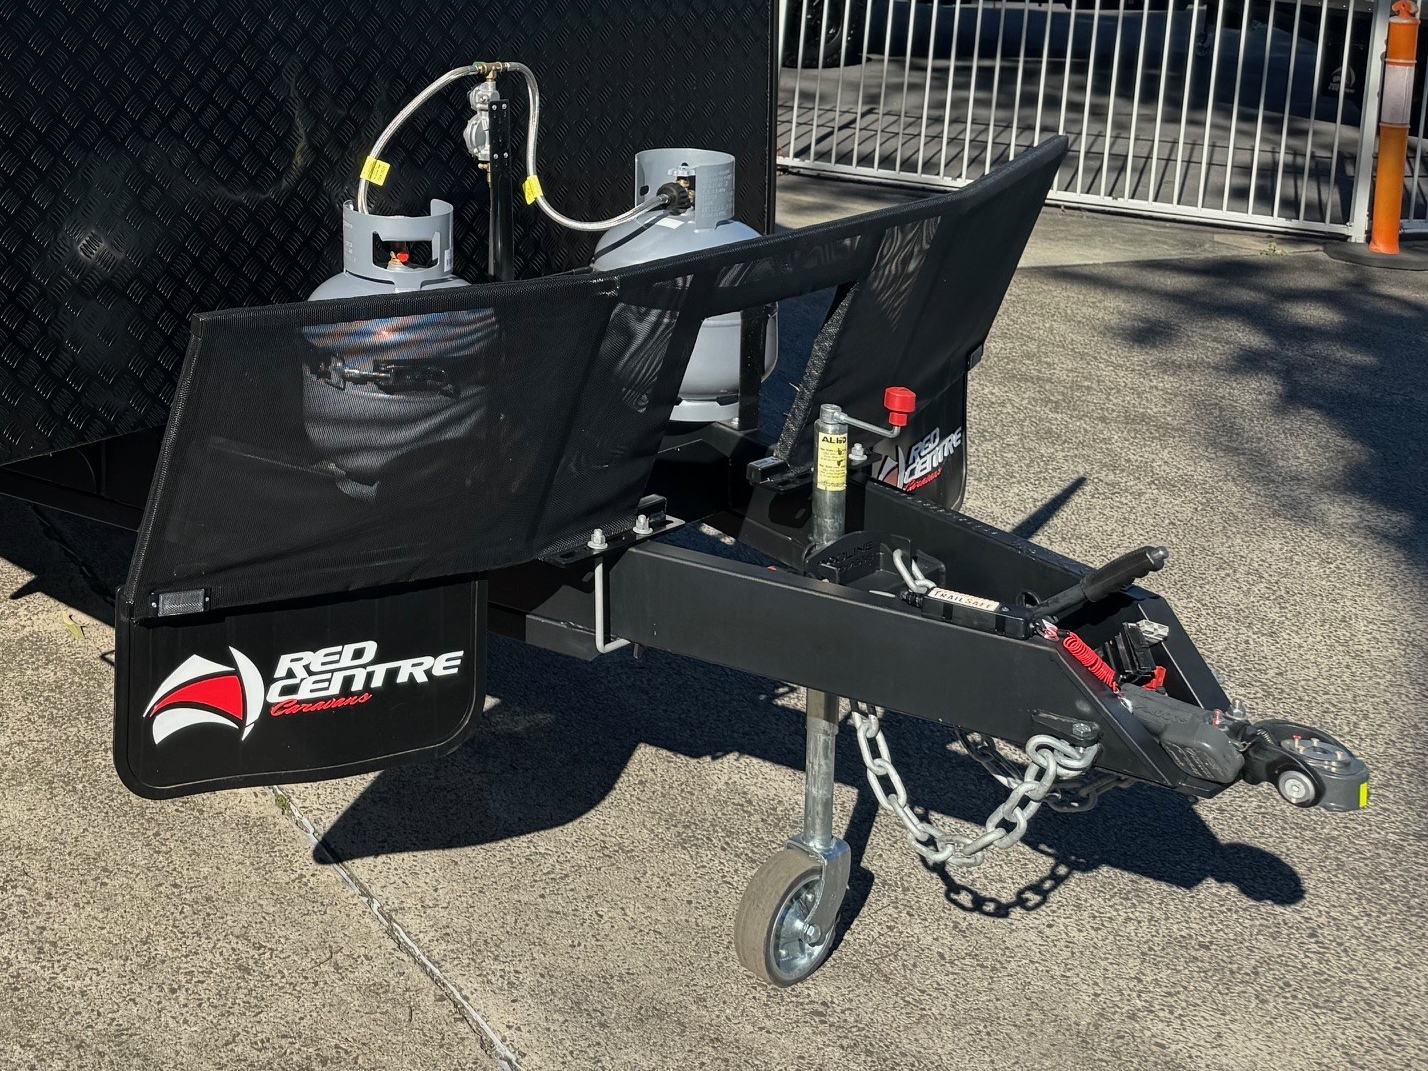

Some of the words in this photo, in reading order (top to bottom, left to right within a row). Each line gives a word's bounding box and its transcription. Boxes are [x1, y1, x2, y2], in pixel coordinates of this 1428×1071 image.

[903, 426, 962, 484] CENTRE
[908, 427, 940, 465] RED
[266, 650, 465, 704] CENTRE
[273, 640, 378, 679] RED
[270, 692, 373, 717] Caravans
